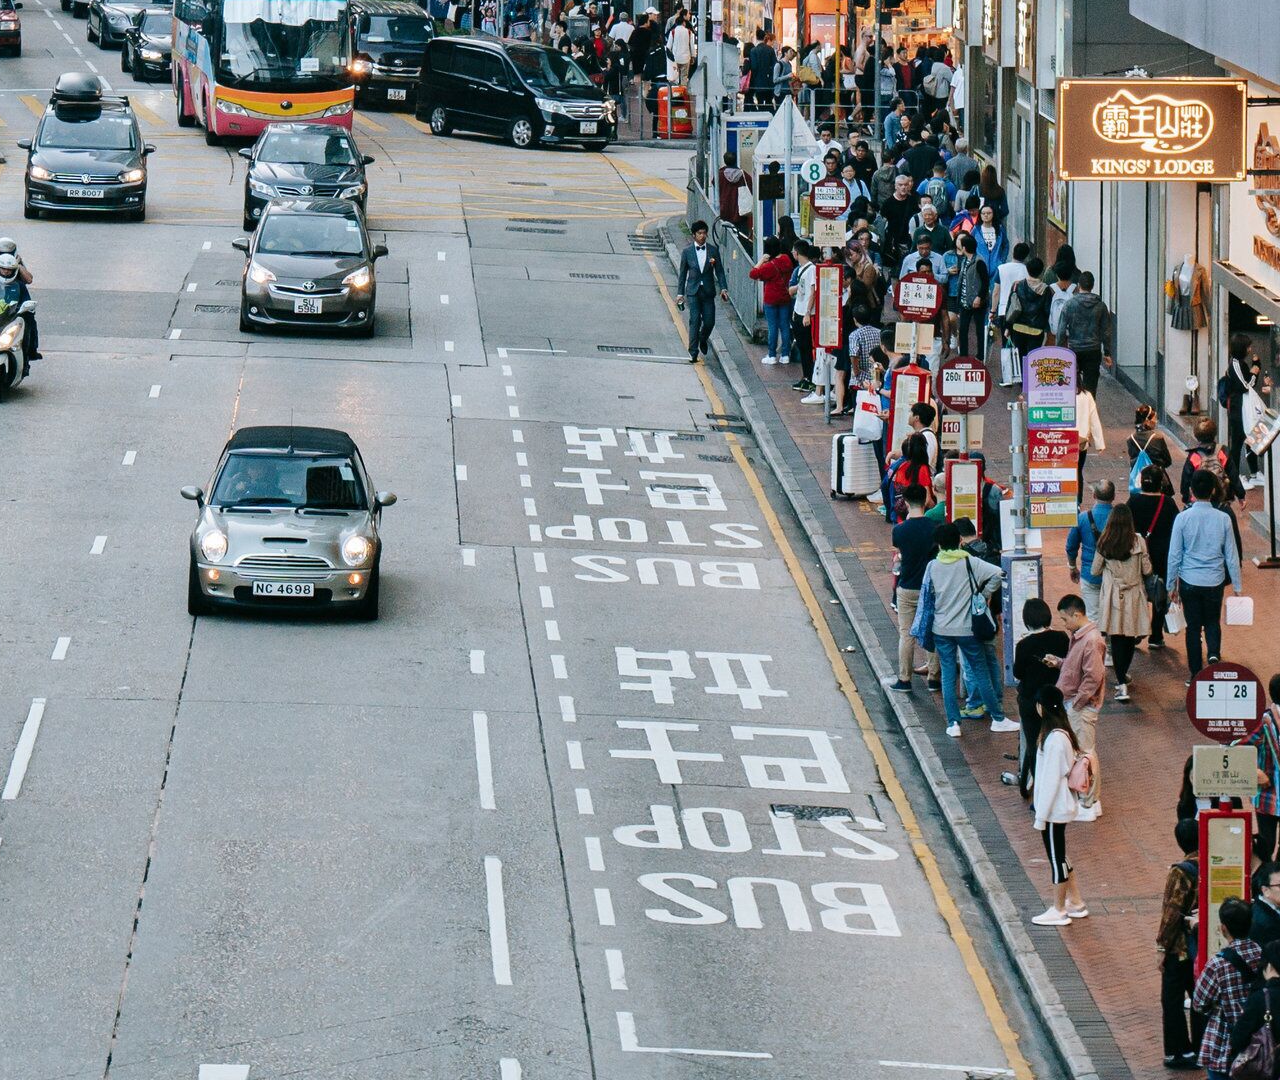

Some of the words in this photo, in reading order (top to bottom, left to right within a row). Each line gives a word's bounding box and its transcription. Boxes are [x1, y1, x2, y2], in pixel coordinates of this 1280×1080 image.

[809, 163, 821, 181] 8
[1090, 159, 1151, 175] KINGS'
[1154, 159, 1215, 175] LODGE
[69, 189, 80, 198] RR
[297, 305, 319, 313] 5961
[302, 298, 315, 306] SU
[967, 371, 981, 382] 110
[943, 422, 959, 432] 110
[1032, 445, 1050, 455] A20
[1051, 445, 1068, 455] A21
[546, 515, 764, 551] STOP
[570, 553, 761, 591] BUS
[255, 583, 273, 594] NC
[277, 583, 312, 595] 4698
[1207, 684, 1215, 698] 5
[1233, 684, 1248, 698] 28
[1222, 755, 1229, 769] 5
[613, 805, 899, 861] STOP
[636, 872, 903, 938] BUS
